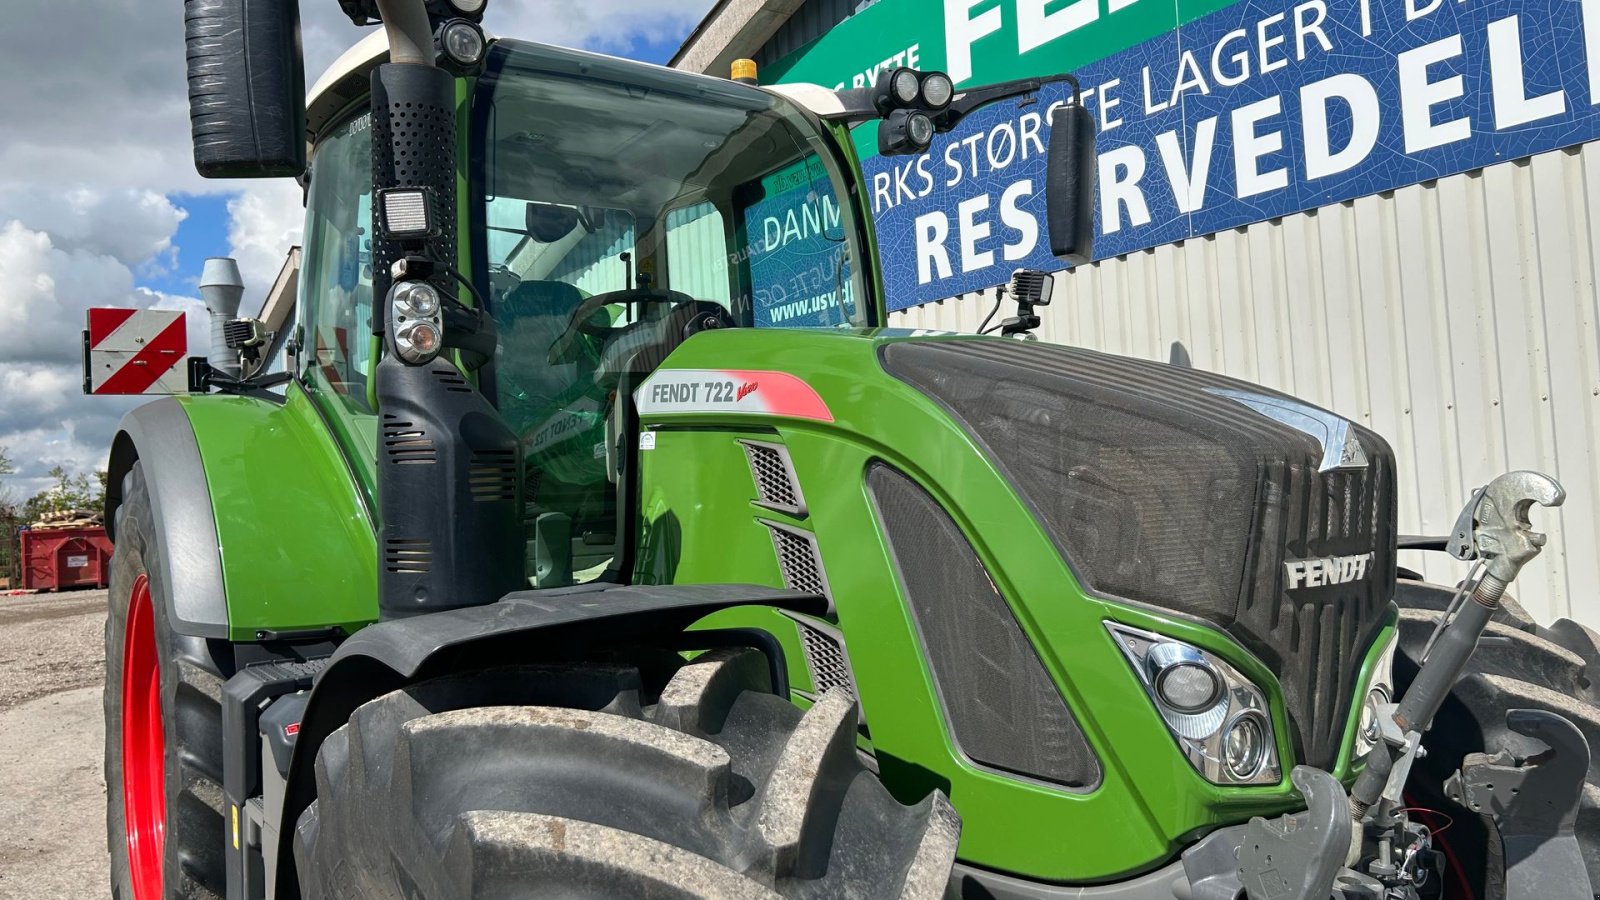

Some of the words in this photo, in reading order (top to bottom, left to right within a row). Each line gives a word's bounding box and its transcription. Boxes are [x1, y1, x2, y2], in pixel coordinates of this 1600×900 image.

[1142, 0, 1333, 115] LAGER
[914, 0, 1600, 286] RESRVEDEL
[770, 279, 854, 323] www.usv.d
[652, 383, 699, 403] FENDT
[705, 381, 734, 403] 722
[1283, 553, 1370, 589] FENDT
